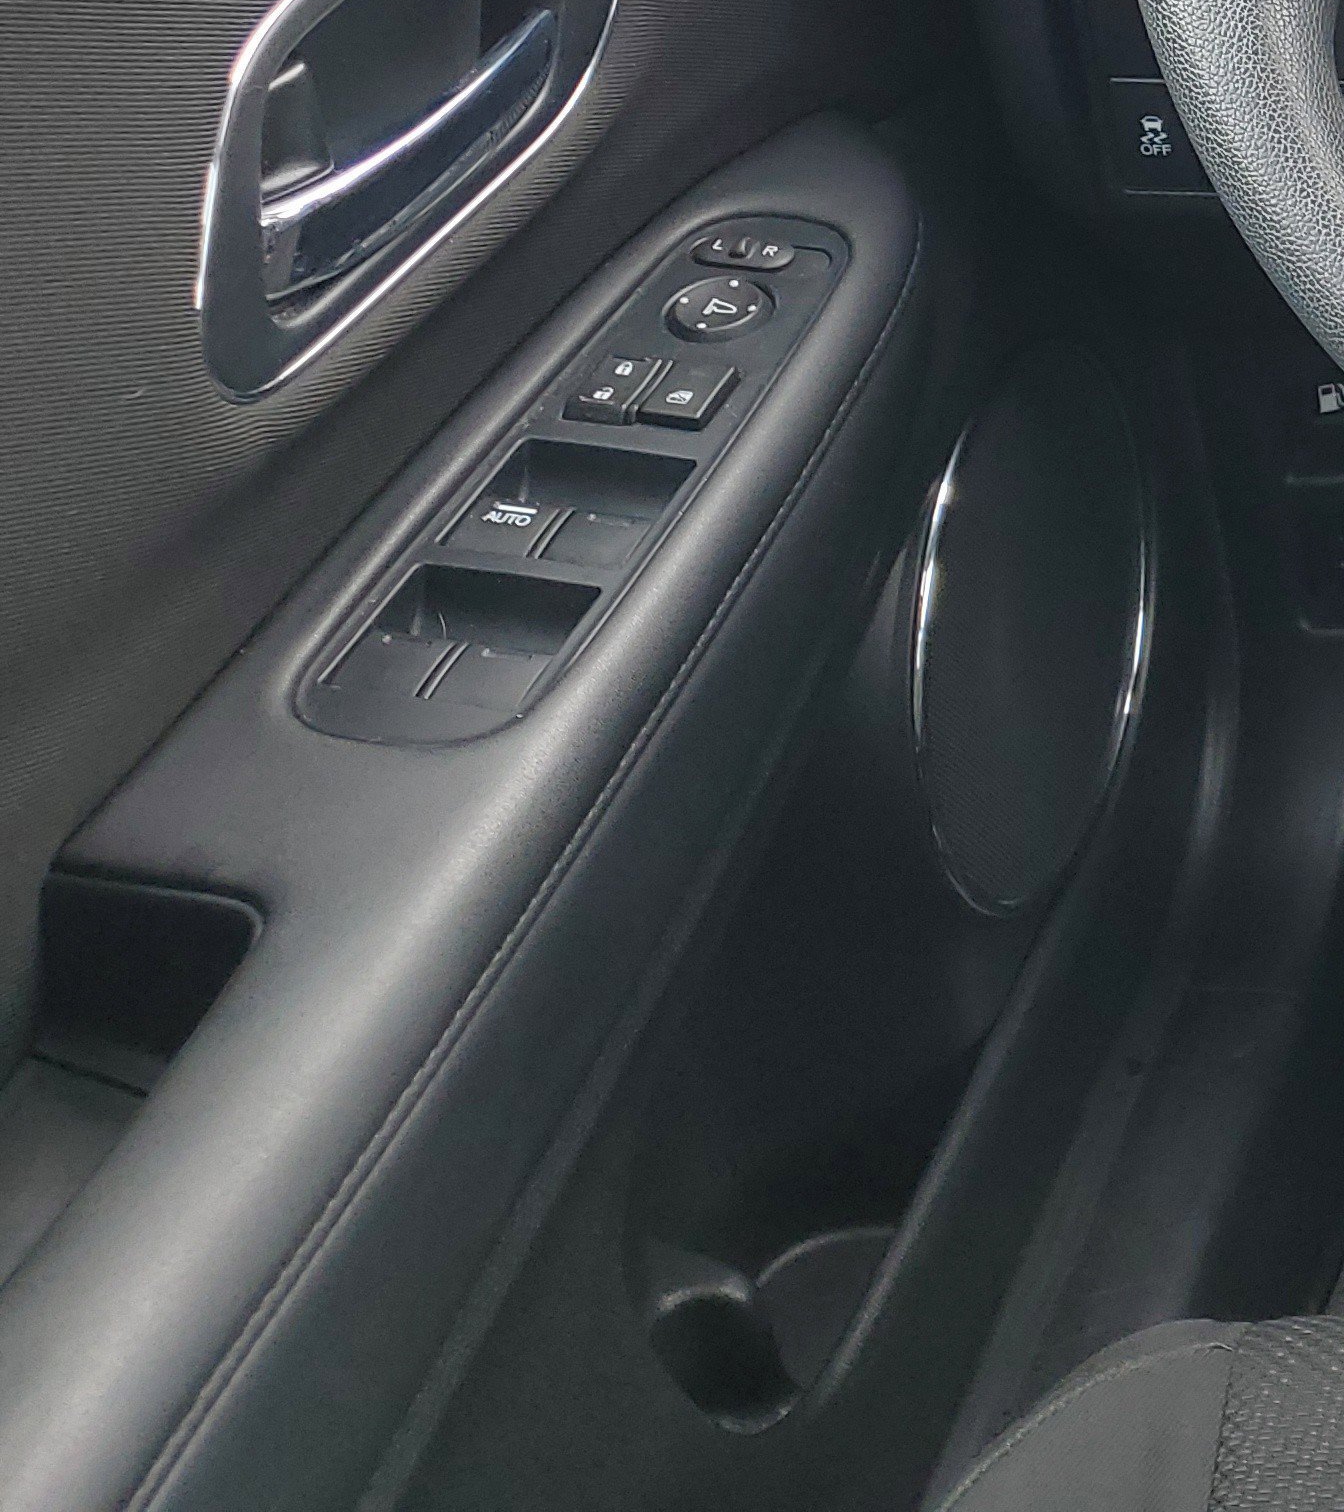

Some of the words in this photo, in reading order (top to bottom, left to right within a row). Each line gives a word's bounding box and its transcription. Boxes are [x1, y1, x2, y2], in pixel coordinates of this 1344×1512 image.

[1140, 144, 1172, 156] OFF
[763, 244, 778, 257] R
[481, 510, 533, 527] AUTO
